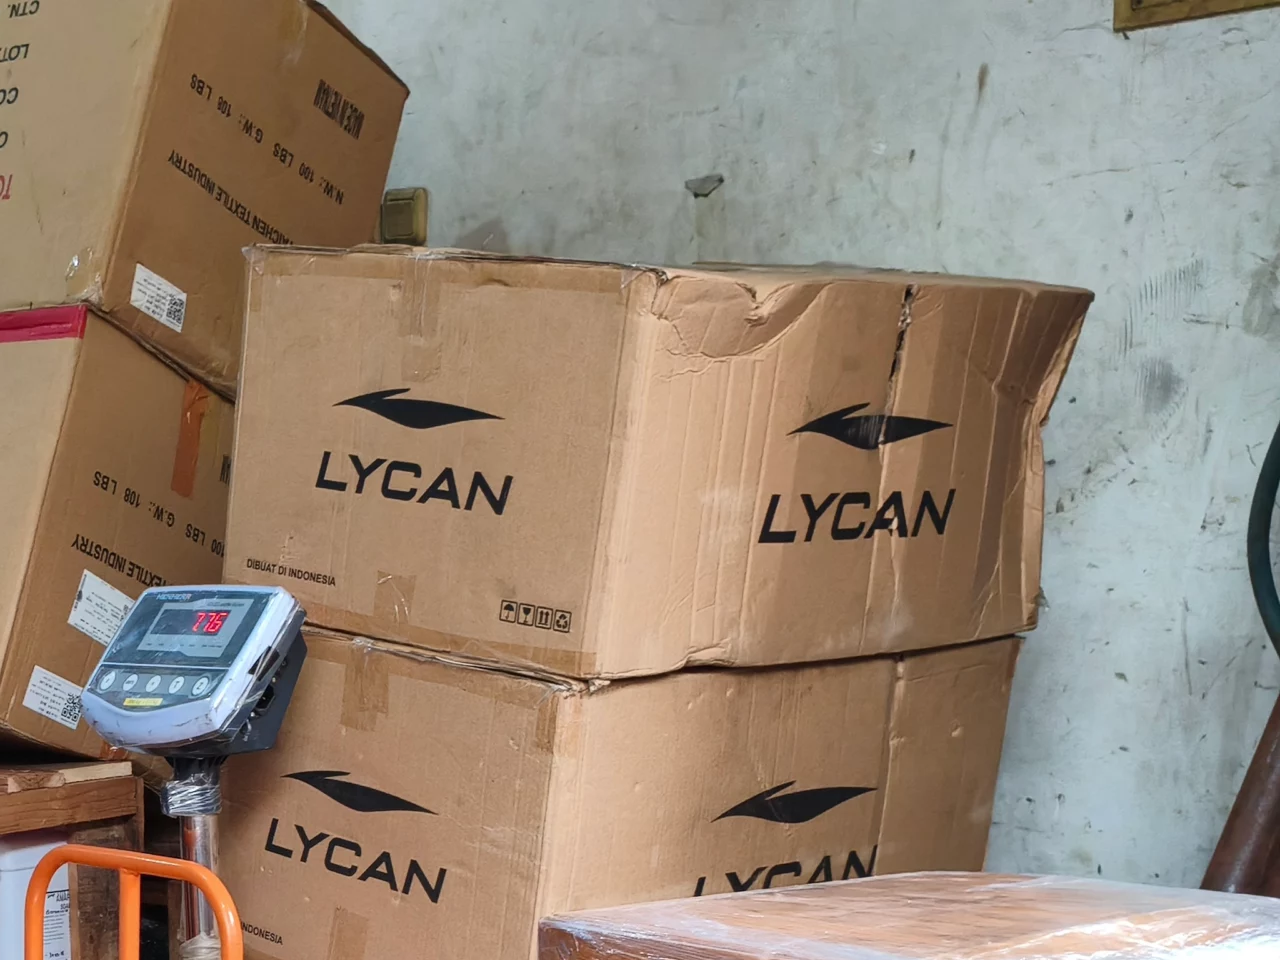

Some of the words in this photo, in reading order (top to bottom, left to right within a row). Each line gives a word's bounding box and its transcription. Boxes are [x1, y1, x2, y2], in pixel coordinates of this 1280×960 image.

[9, 1, 40, 14] CTN.
[190, 74, 213, 100] LBS
[272, 143, 294, 168] LBS
[168, 149, 216, 196] INDUSTRY
[215, 186, 253, 226] TEXTILE
[93, 470, 117, 495] LBS
[315, 451, 514, 516] LYCAN
[123, 488, 141, 508] 108
[758, 489, 956, 543] LYCAN
[185, 523, 206, 546] LBS
[71, 533, 130, 574] INDUSTRY
[246, 558, 277, 575] DIBUAT
[278, 563, 287, 576] DI
[289, 565, 337, 587] INDONESIA
[264, 818, 447, 904] LYCAN
